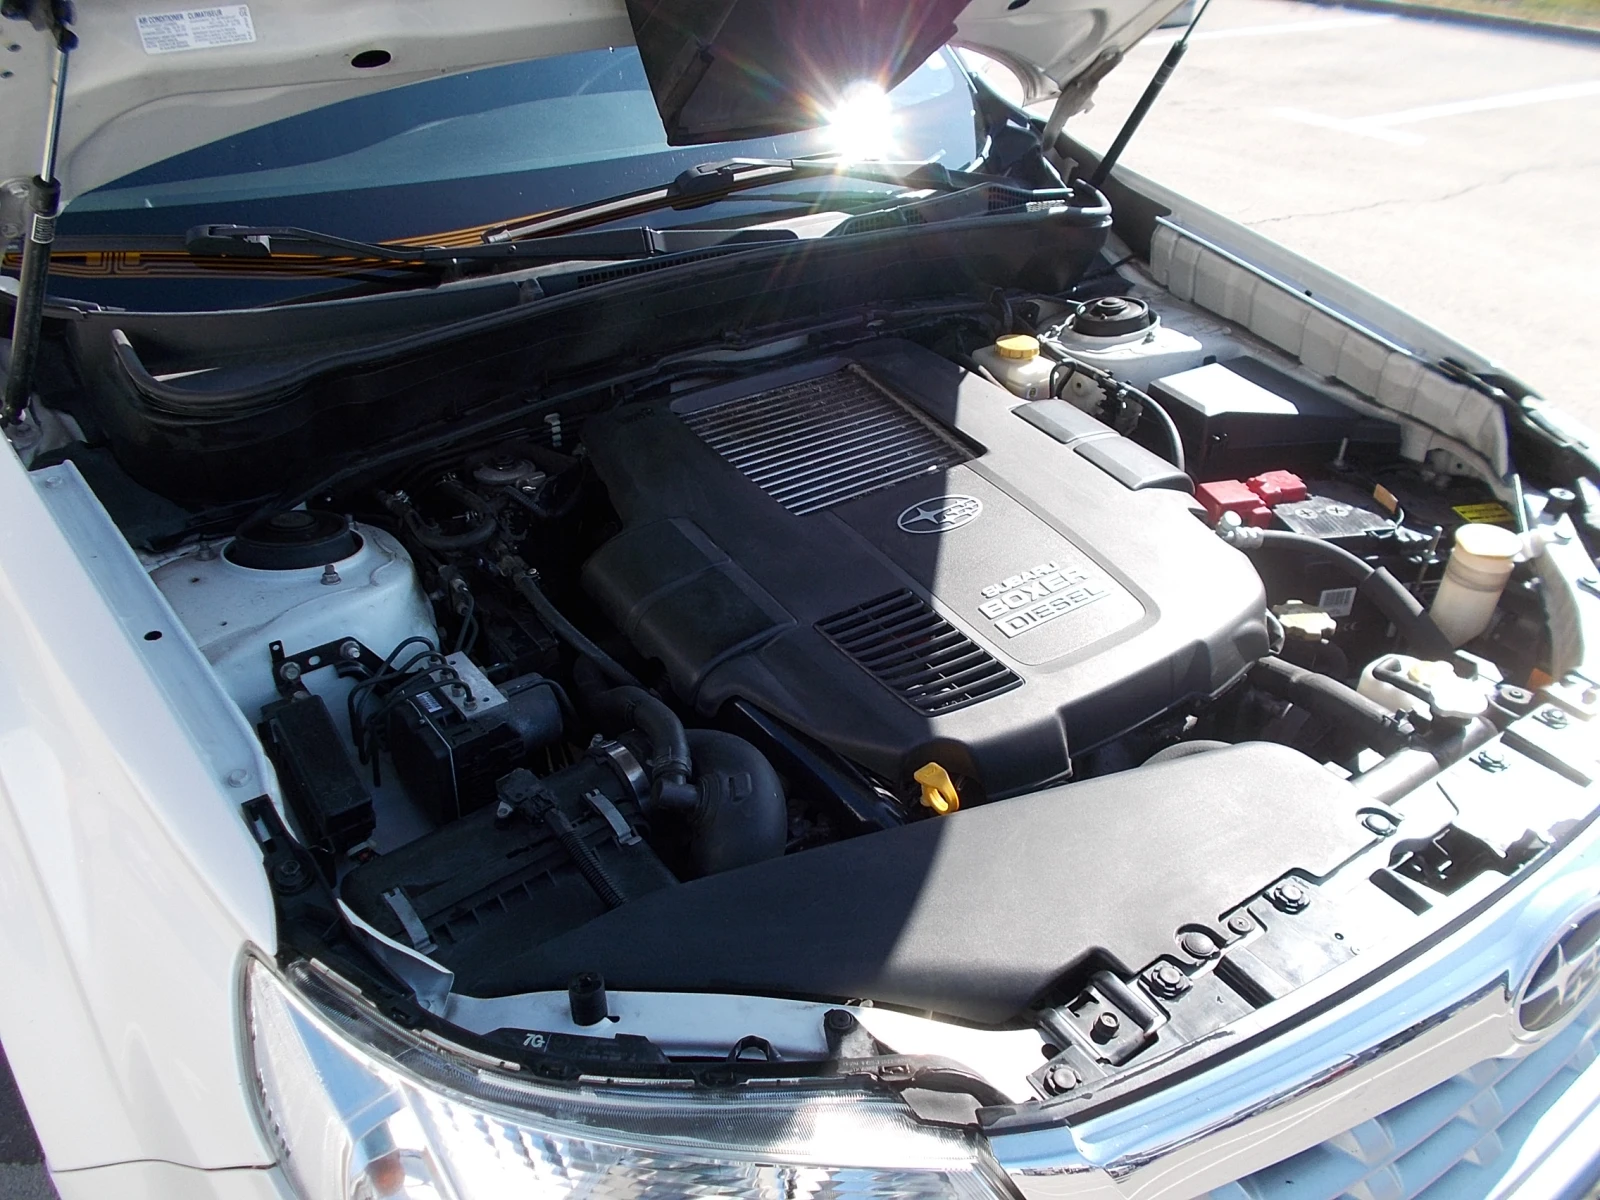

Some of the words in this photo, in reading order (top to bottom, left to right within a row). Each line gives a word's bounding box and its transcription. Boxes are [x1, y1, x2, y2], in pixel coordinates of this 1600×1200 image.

[978, 565, 1090, 620] BOXER
[981, 560, 1060, 599] SUBARU
[1004, 587, 1105, 630] DIESEL
